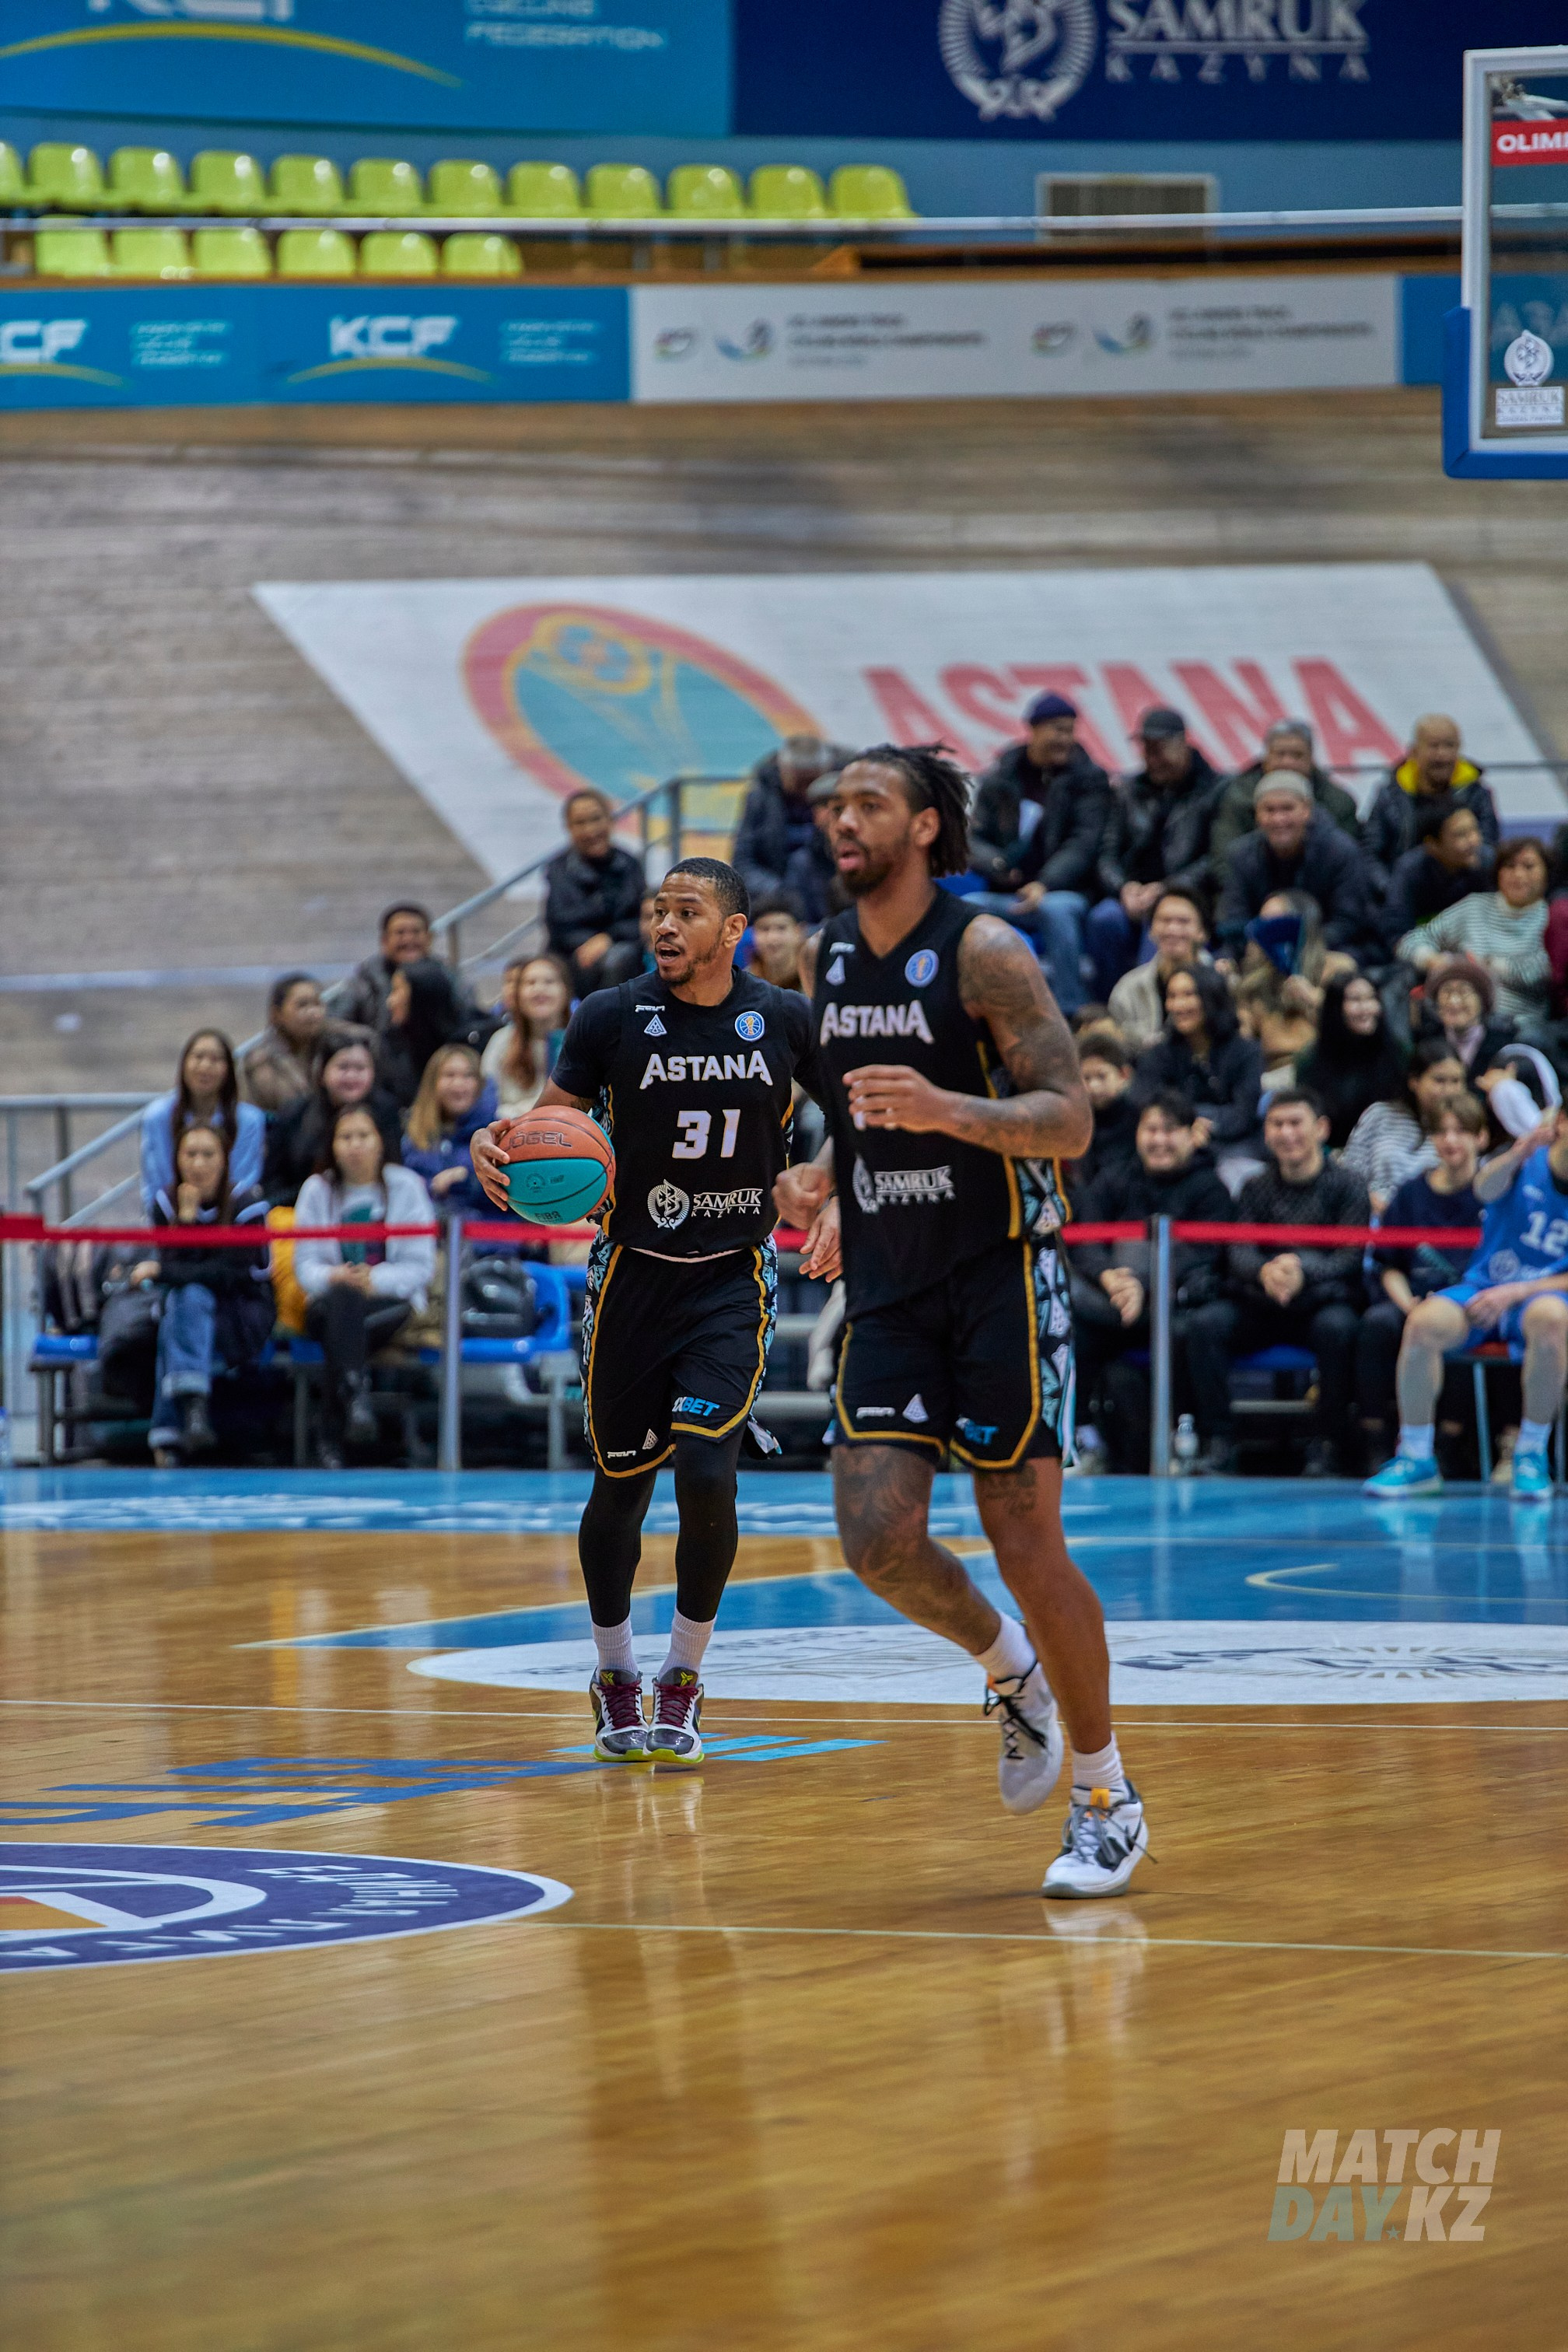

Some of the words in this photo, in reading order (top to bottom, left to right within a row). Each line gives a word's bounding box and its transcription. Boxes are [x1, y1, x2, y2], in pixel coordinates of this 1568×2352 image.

[1108, 0, 1367, 40] SAMRUK
[1105, 53, 1371, 84] KAZYNA
[329, 314, 458, 360] KCF
[860, 657, 1405, 776] ASTANA
[820, 1000, 933, 1046] ASTANA
[639, 1050, 774, 1089] ASTANA
[672, 1109, 741, 1159] 31
[874, 1168, 952, 1190] SAMRUK
[691, 1206, 760, 1219] KAZYNA
[693, 1190, 763, 1209] SAMRUK
[671, 1397, 720, 1416] 1XBET
[247, 1865, 460, 1916] ЕДИНАЯ
